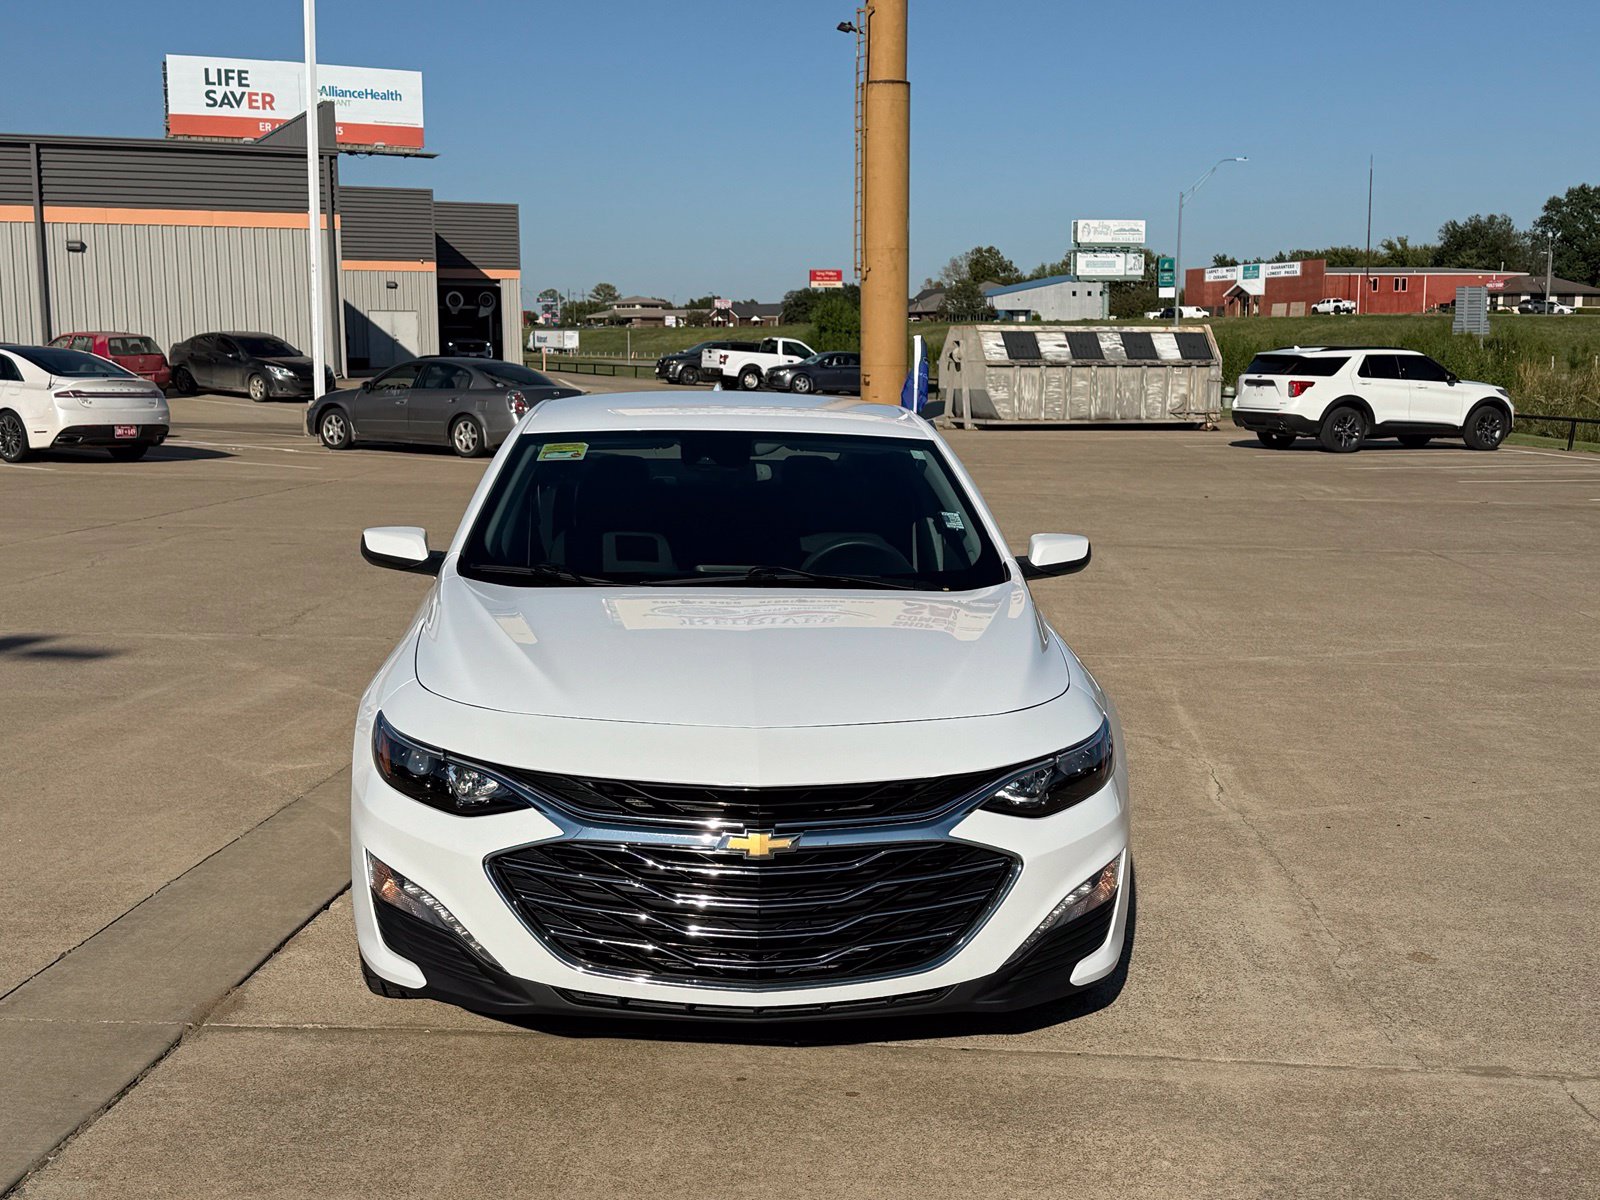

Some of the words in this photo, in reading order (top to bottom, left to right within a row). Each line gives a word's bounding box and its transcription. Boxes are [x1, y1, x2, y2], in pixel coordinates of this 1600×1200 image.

[204, 67, 250, 88] LIFE
[204, 89, 276, 111] SAVER
[319, 85, 402, 102] AllianceHealth
[259, 122, 272, 132] ER
